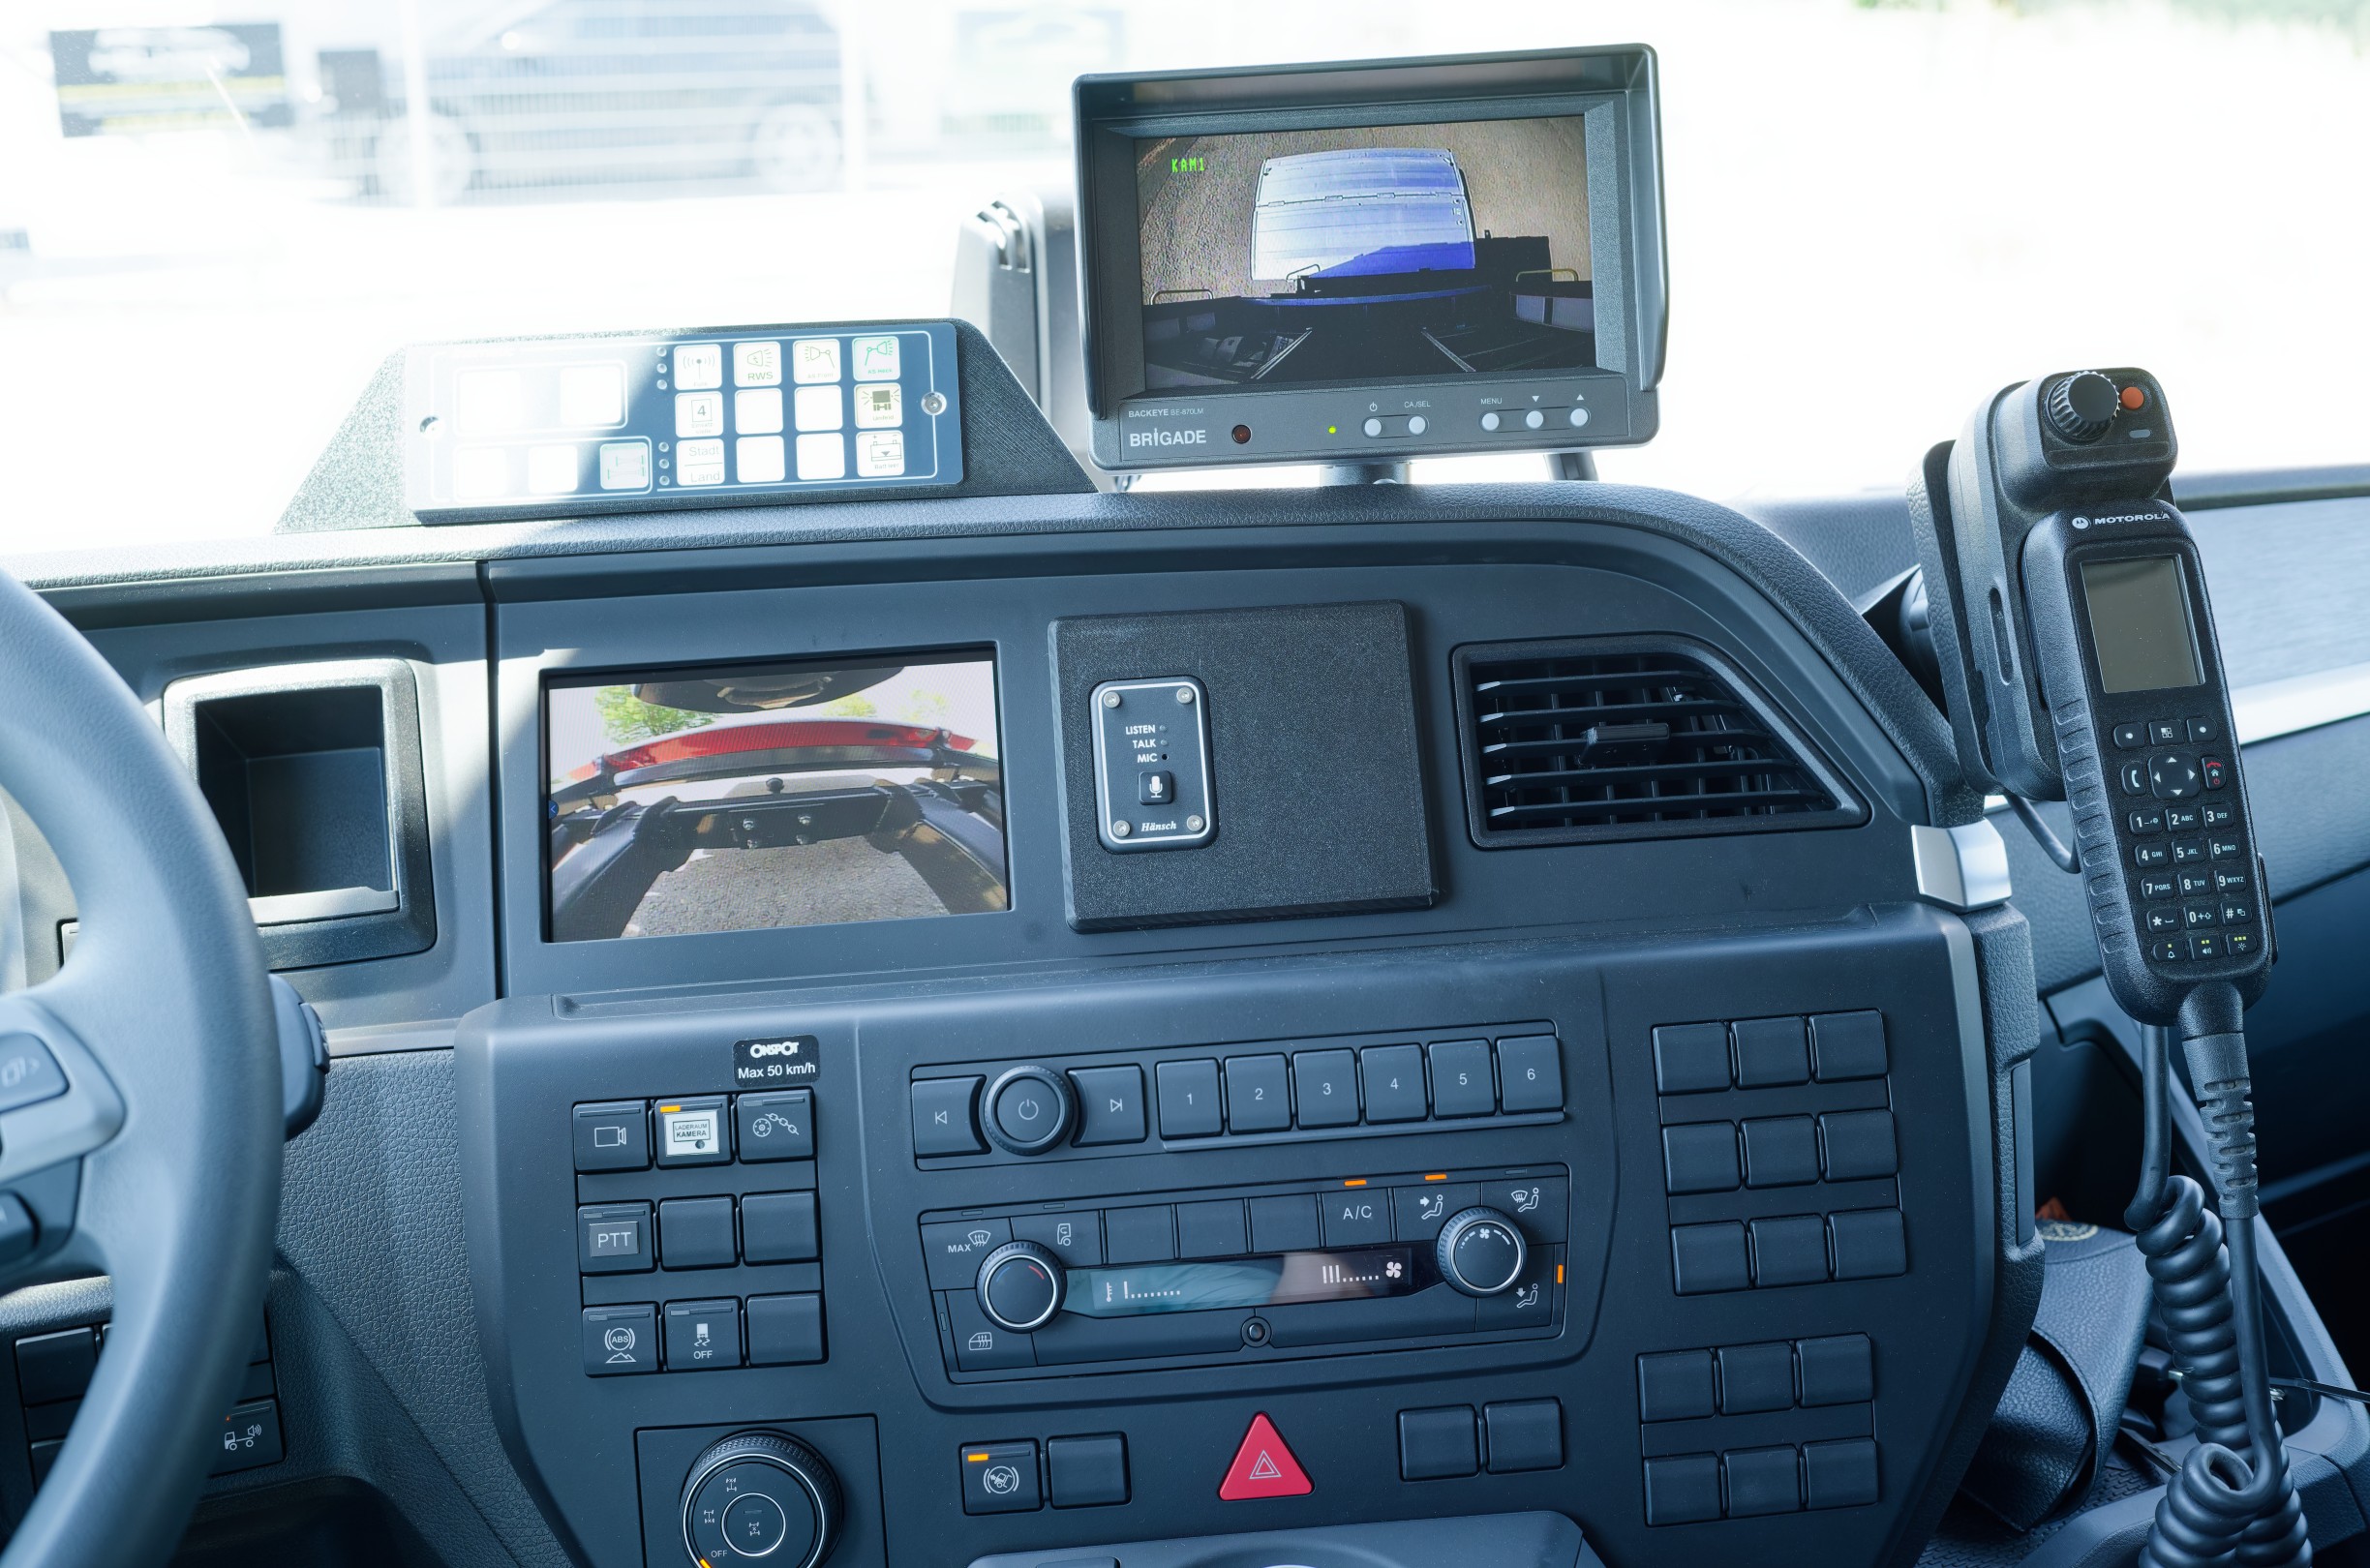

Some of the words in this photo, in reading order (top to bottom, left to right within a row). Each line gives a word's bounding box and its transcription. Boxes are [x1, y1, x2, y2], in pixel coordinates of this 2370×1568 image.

[1171, 157, 1205, 173] KAM1
[747, 372, 774, 381] RWS
[697, 405, 707, 416] 4
[1128, 408, 1170, 418] BACKEYE
[1170, 407, 1204, 416] BE-870LM
[1129, 428, 1207, 447] BRIGADE
[688, 445, 719, 457] Stadt
[690, 471, 720, 483] Land
[2094, 513, 2171, 525] MOTOROLA
[1125, 724, 1156, 736] LISTEN
[1132, 739, 1157, 749] TALK
[1137, 753, 1158, 764] MIC
[2136, 816, 2143, 828] 1
[2171, 813, 2179, 826] 2
[2206, 810, 2215, 823] 3
[1140, 820, 1177, 832] Hänsch
[2141, 849, 2149, 861] 4
[2176, 847, 2185, 859] 5
[2213, 843, 2221, 855] 6
[2183, 878, 2192, 890] 8
[2218, 875, 2227, 887] 9
[2145, 883, 2153, 894] 7
[2189, 911, 2197, 923] 0
[749, 1040, 800, 1059] ONSPOT
[738, 1068, 764, 1079] Max
[767, 1065, 783, 1076] 50
[785, 1062, 816, 1075] km/h
[1527, 1068, 1536, 1080] 6
[1389, 1077, 1399, 1090] 4
[1459, 1072, 1468, 1085] 5
[1255, 1087, 1264, 1101] 2
[1322, 1082, 1332, 1096] 3
[1186, 1092, 1193, 1105] 1
[674, 1123, 708, 1131] LADERAUM
[676, 1130, 708, 1138] KAMERA
[1343, 1205, 1373, 1221] A/C
[597, 1231, 631, 1249] PTT
[947, 1243, 971, 1254] MAX
[611, 1335, 629, 1343] ABS
[693, 1350, 713, 1360] OFF
[711, 1550, 728, 1558] OFF
